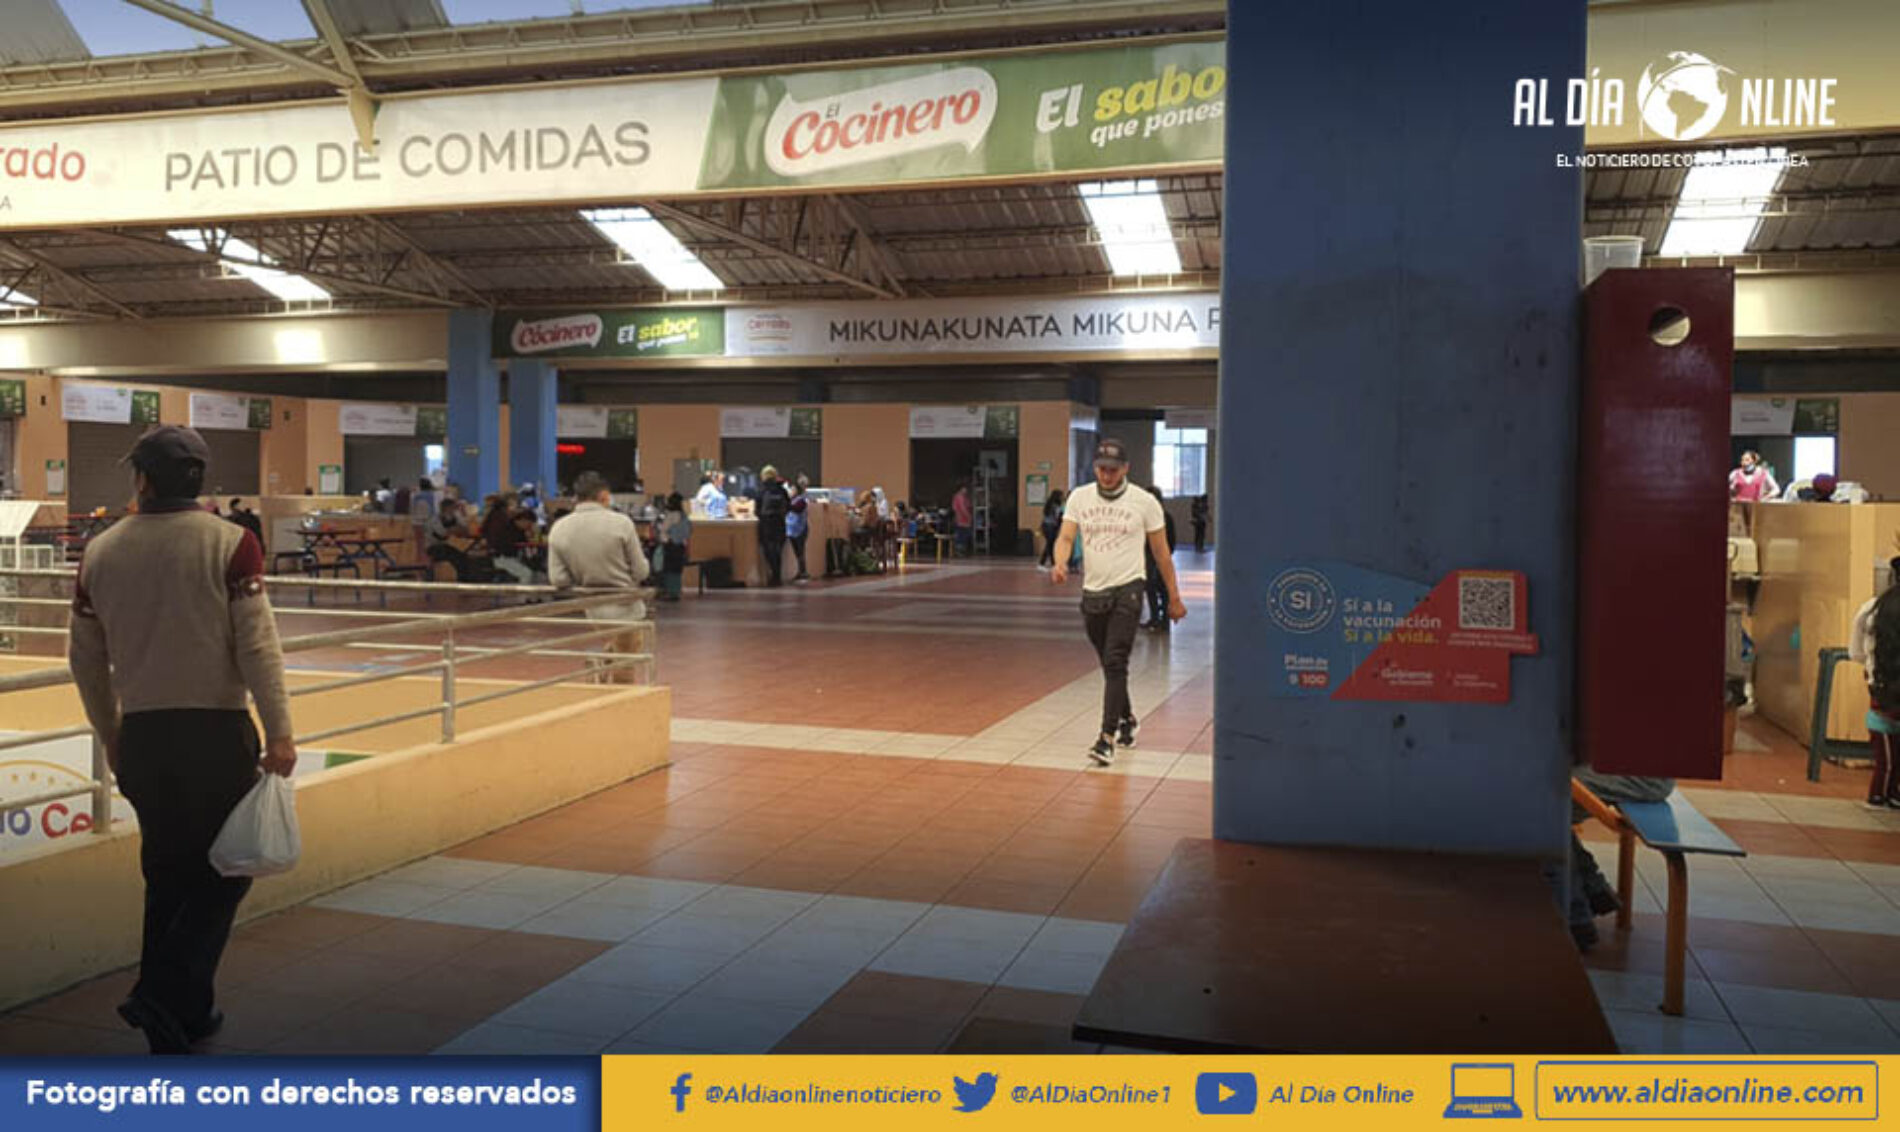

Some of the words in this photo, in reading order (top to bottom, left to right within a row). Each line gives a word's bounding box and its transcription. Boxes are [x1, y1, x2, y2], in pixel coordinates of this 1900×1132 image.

[1036, 83, 1084, 133] El
[1094, 64, 1226, 121] sabo
[782, 88, 981, 160] Cocinero
[1091, 118, 1139, 147] que
[1143, 100, 1226, 138] pones
[165, 145, 298, 192] PATIO
[316, 140, 381, 183] DE
[400, 121, 651, 178] COMIDAS
[617, 324, 635, 344] El
[638, 317, 698, 339] sabor
[829, 313, 1062, 343] MIKUNAKUNATA
[1073, 308, 1197, 337] MIKUNA
[1343, 612, 1442, 630] vacunación
[1362, 601, 1373, 612] a
[1377, 598, 1393, 612] la
[1378, 629, 1393, 643] la
